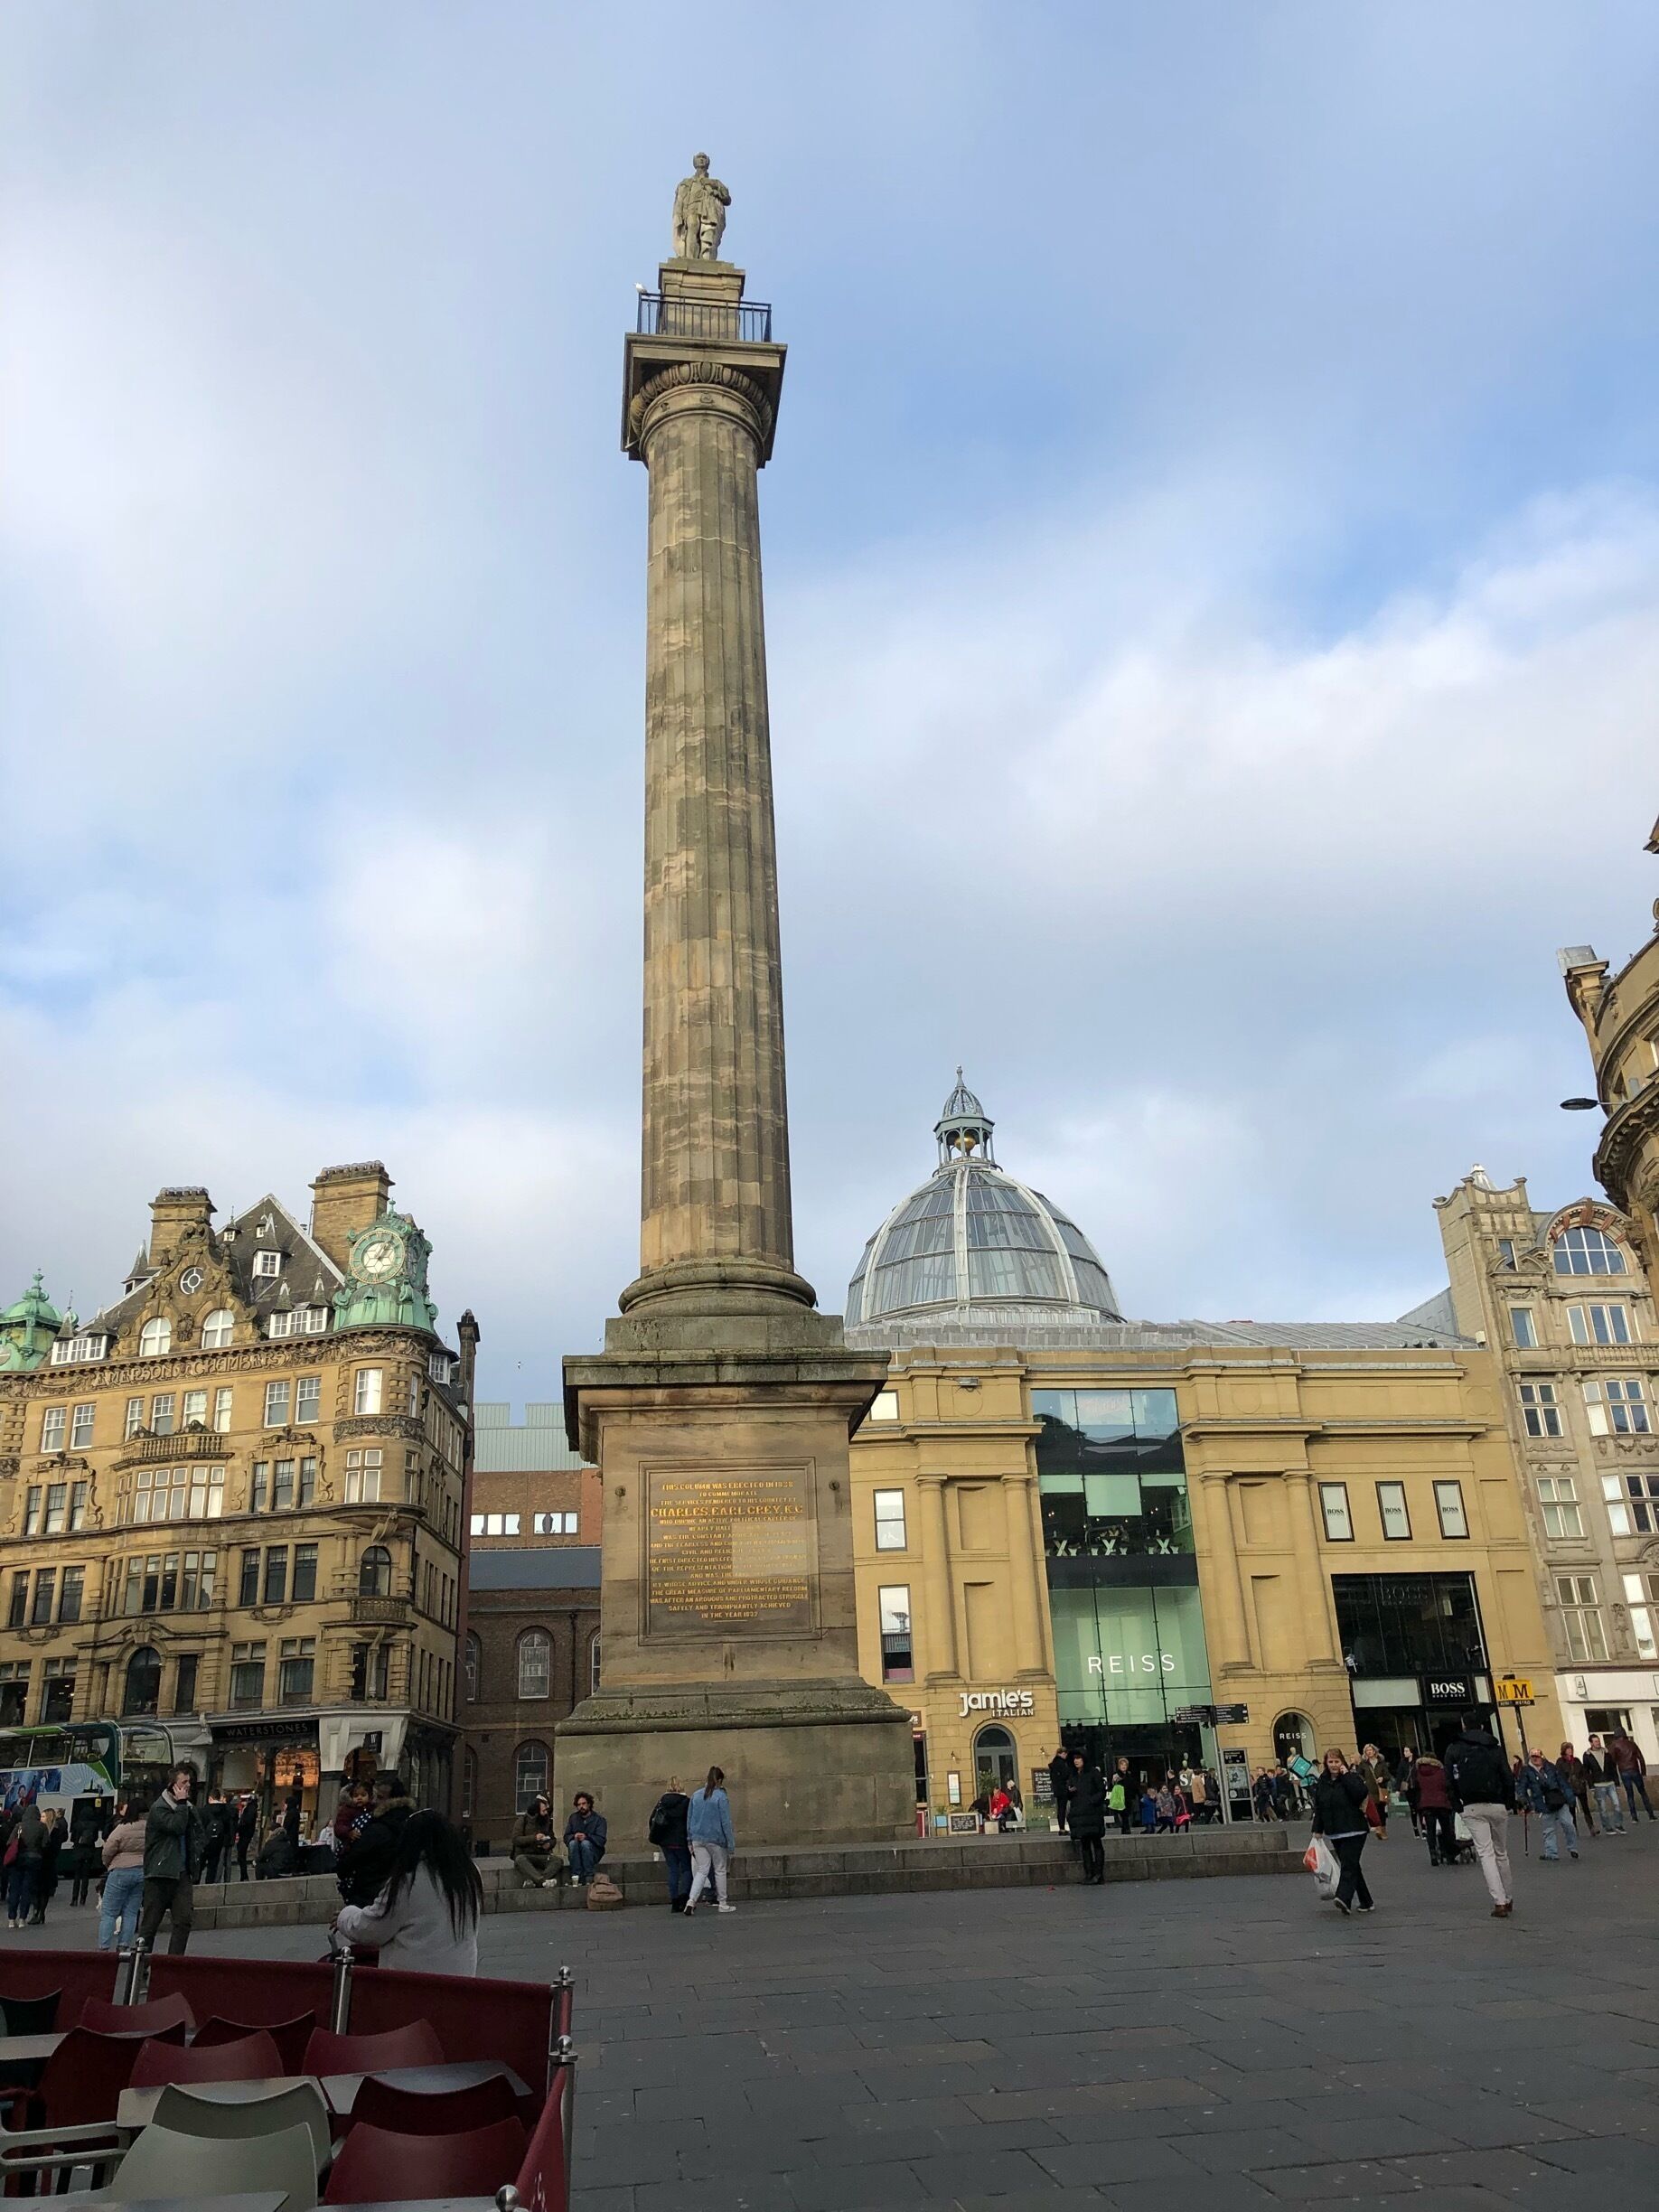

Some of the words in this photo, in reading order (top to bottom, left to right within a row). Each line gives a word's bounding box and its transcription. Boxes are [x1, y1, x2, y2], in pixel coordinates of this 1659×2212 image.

[711, 1505, 745, 1516] EARL
[1087, 1654, 1175, 1674] REISS
[1431, 1682, 1465, 1694] BOSS
[1498, 1684, 1509, 1699] M
[1513, 1683, 1530, 1698] M
[992, 1708, 1034, 1717] ITALIAN
[226, 1722, 309, 1737] WATERSTONES
[1279, 1732, 1307, 1740] REISS
